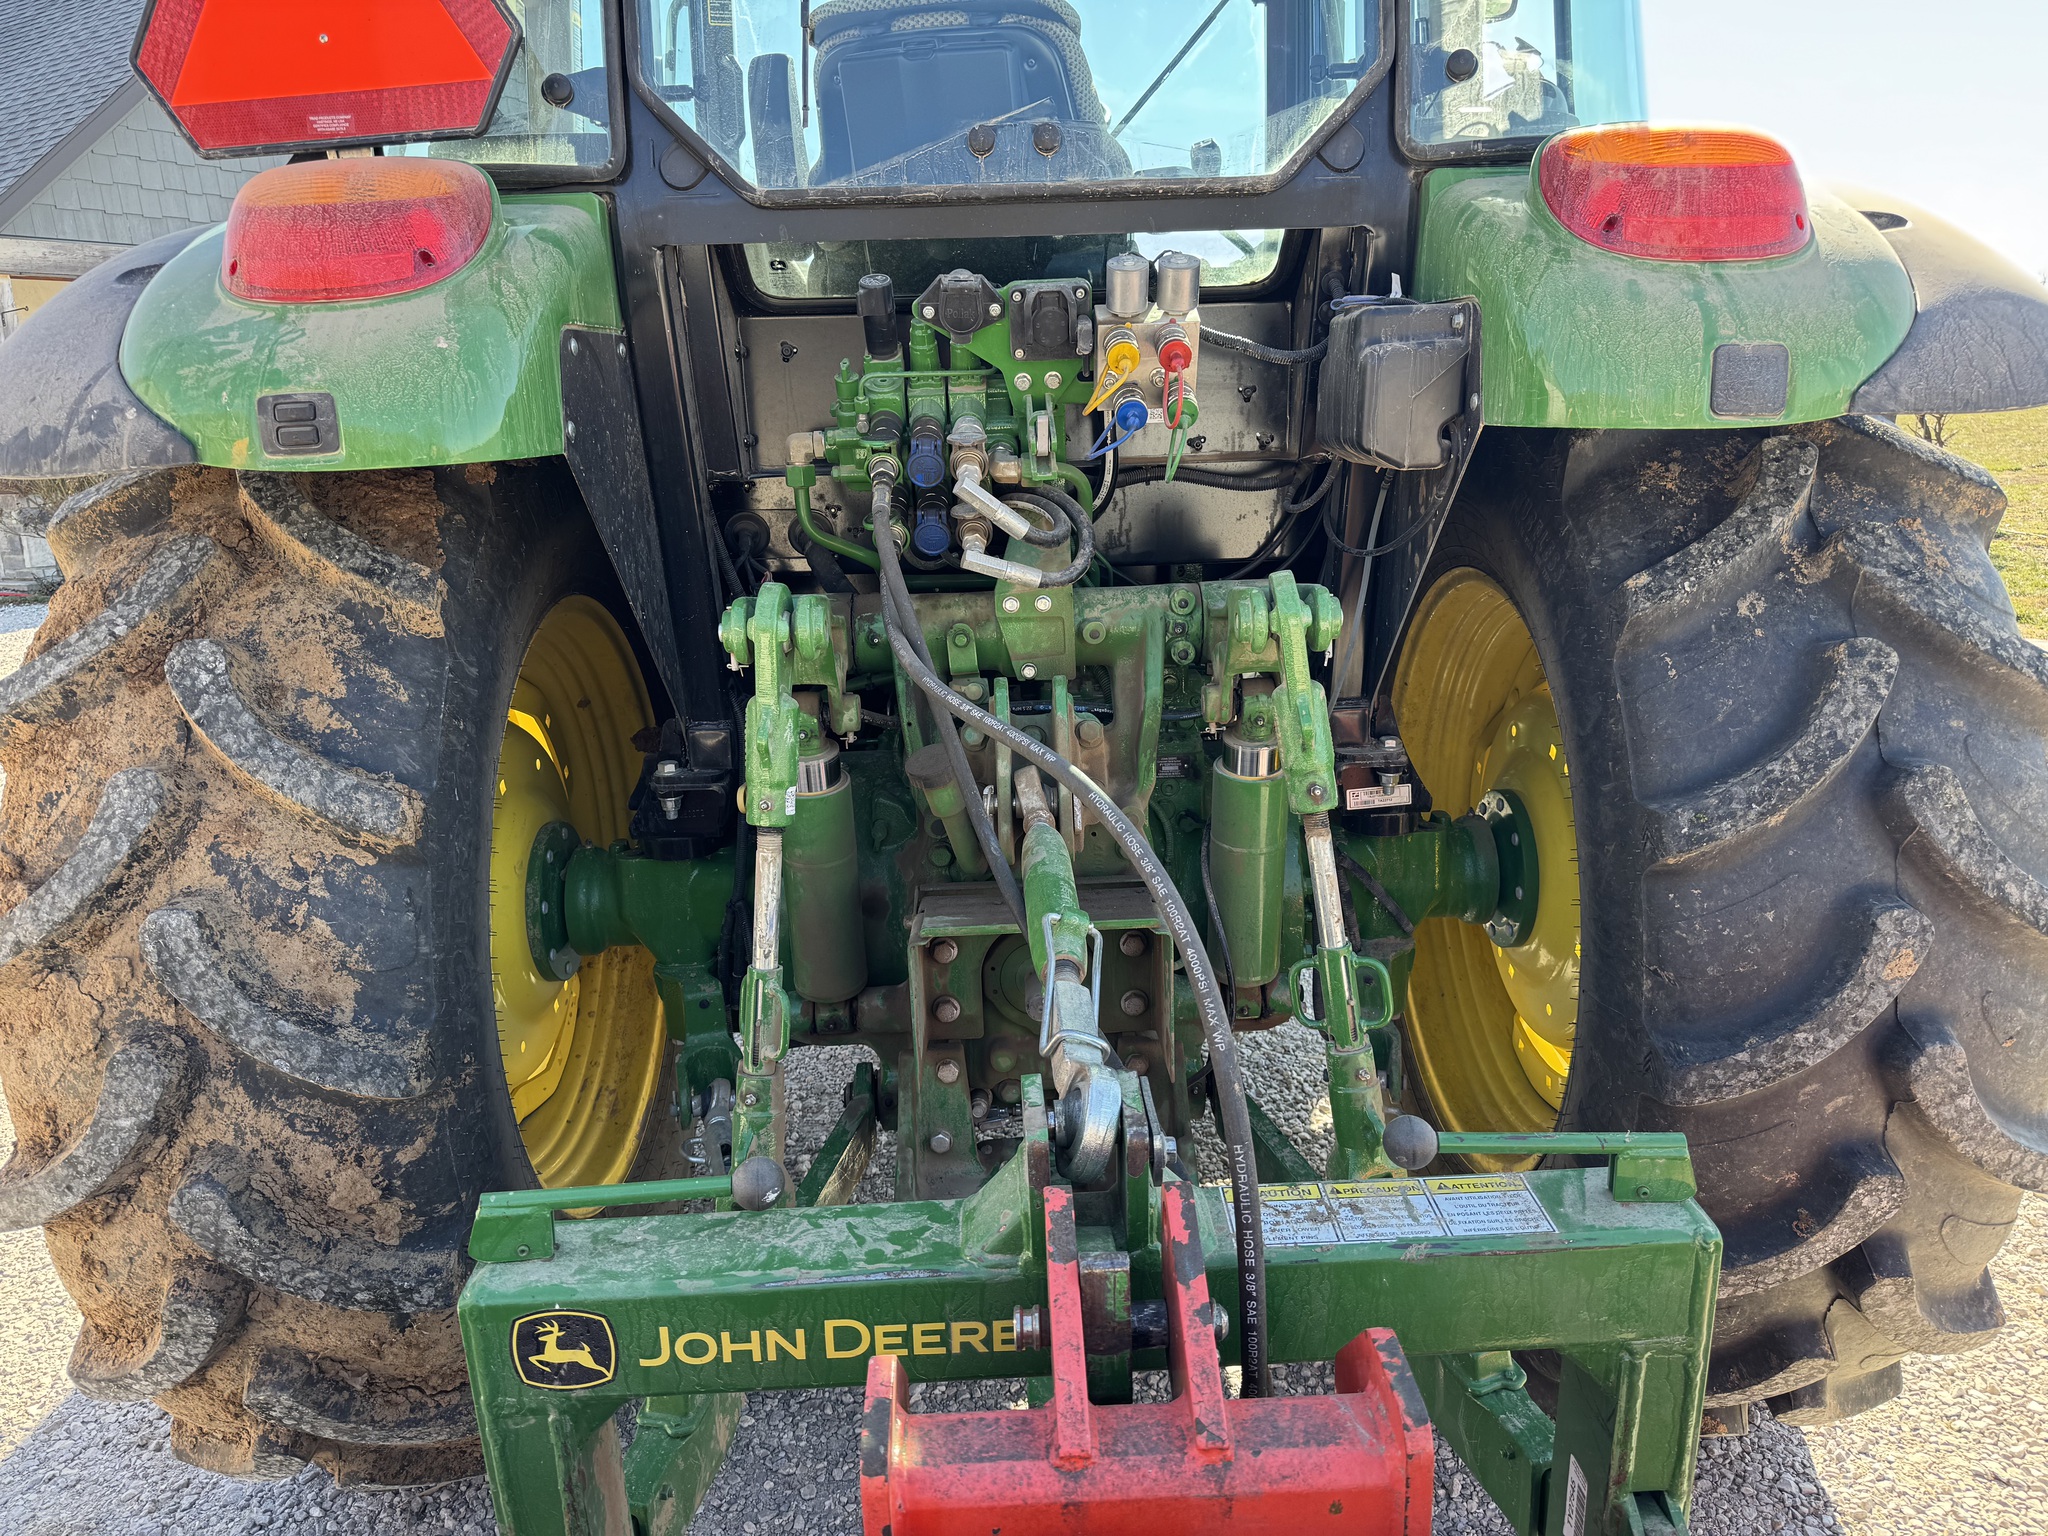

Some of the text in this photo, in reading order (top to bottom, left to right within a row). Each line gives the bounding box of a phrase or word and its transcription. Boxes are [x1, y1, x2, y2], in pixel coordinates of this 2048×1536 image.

[946, 308, 976, 319] Pollak
[922, 676, 947, 698] HYDRAULIC
[946, 694, 963, 708] HOSE
[970, 709, 984, 720] SAE
[982, 716, 1008, 732] 100R2AT
[1029, 742, 1046, 757] MAX
[1043, 753, 1057, 763] WP
[1088, 791, 1226, 1052] HYDRAULIC HOSE 3/8" SAE 100R2AT 4000PSI MAX WP
[1233, 1144, 1251, 1224] HYDRAULIC
[1259, 1188, 1312, 1198] AUTION
[1242, 1229, 1256, 1267] HOSE
[1245, 1272, 1256, 1297] 3/8"
[1246, 1300, 1257, 1324] SAE
[639, 1319, 1026, 1366] JOHN DEERE
[1246, 1329, 1258, 1379] 100R2AT
